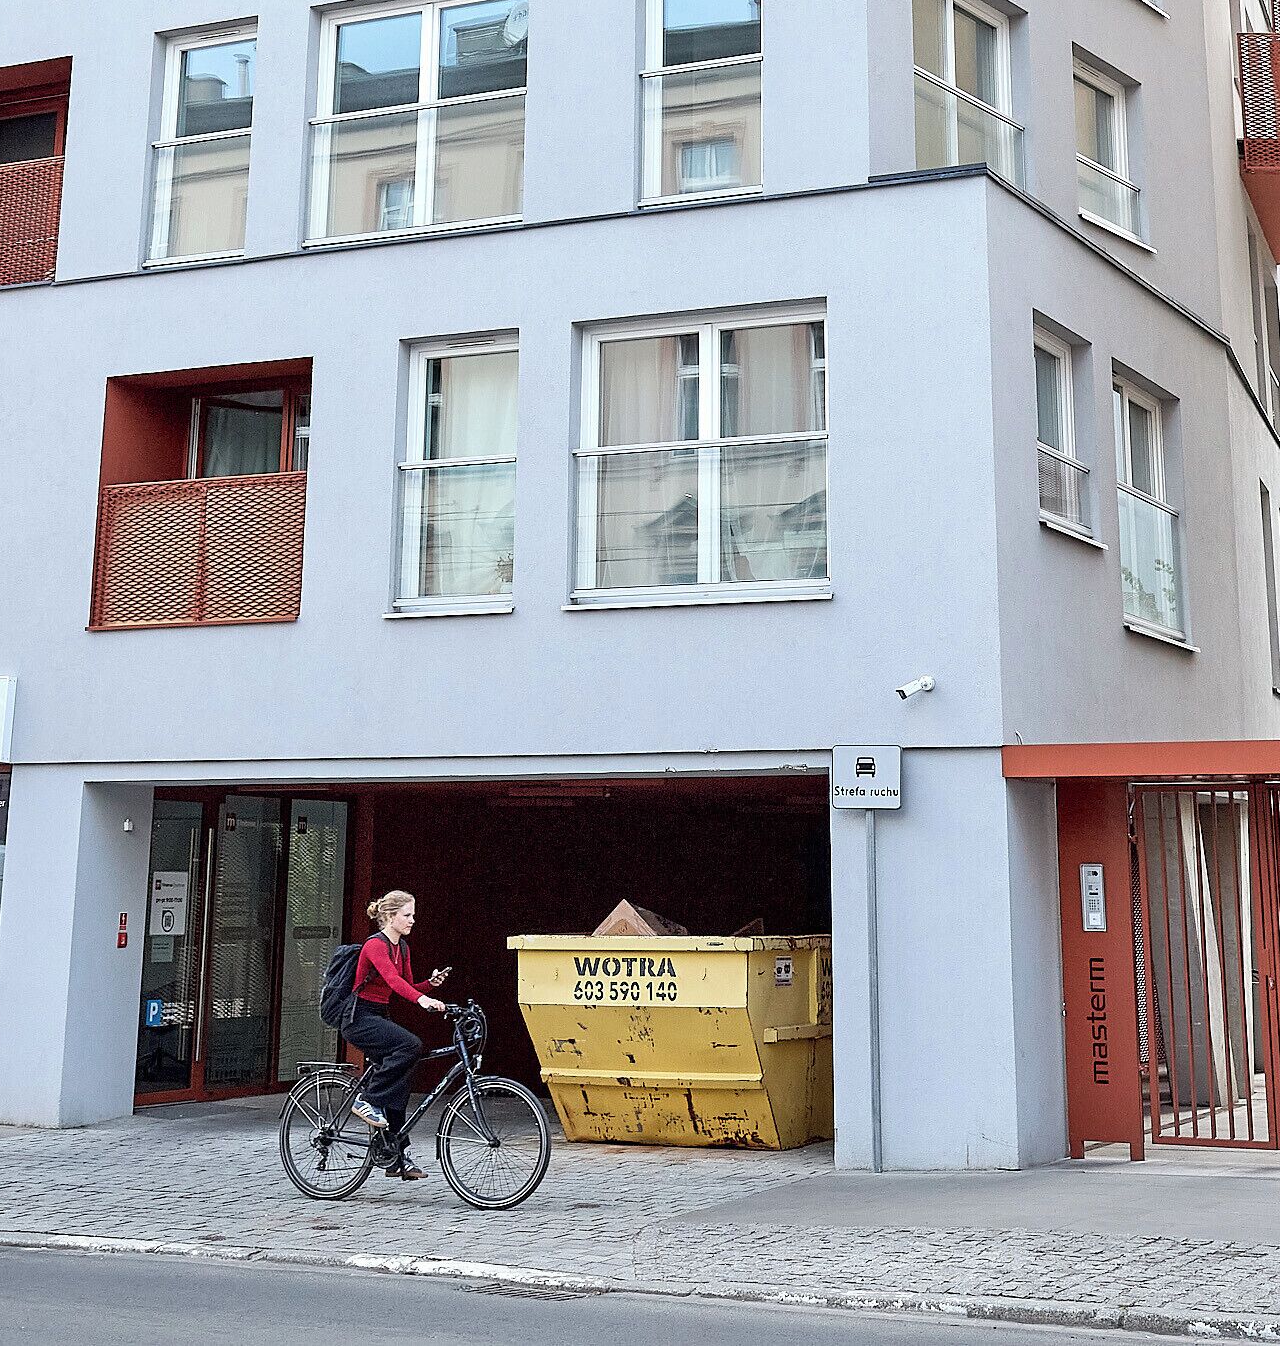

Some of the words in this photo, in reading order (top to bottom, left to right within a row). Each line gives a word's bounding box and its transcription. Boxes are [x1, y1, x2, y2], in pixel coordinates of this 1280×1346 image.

[834, 785, 866, 796] Strefa
[870, 786, 899, 796] ruchu
[574, 957, 677, 977] WOTRA
[574, 981, 604, 1000] 603
[609, 981, 640, 1001] 590
[645, 981, 677, 1001] 140
[1086, 957, 1109, 1085] masterm
